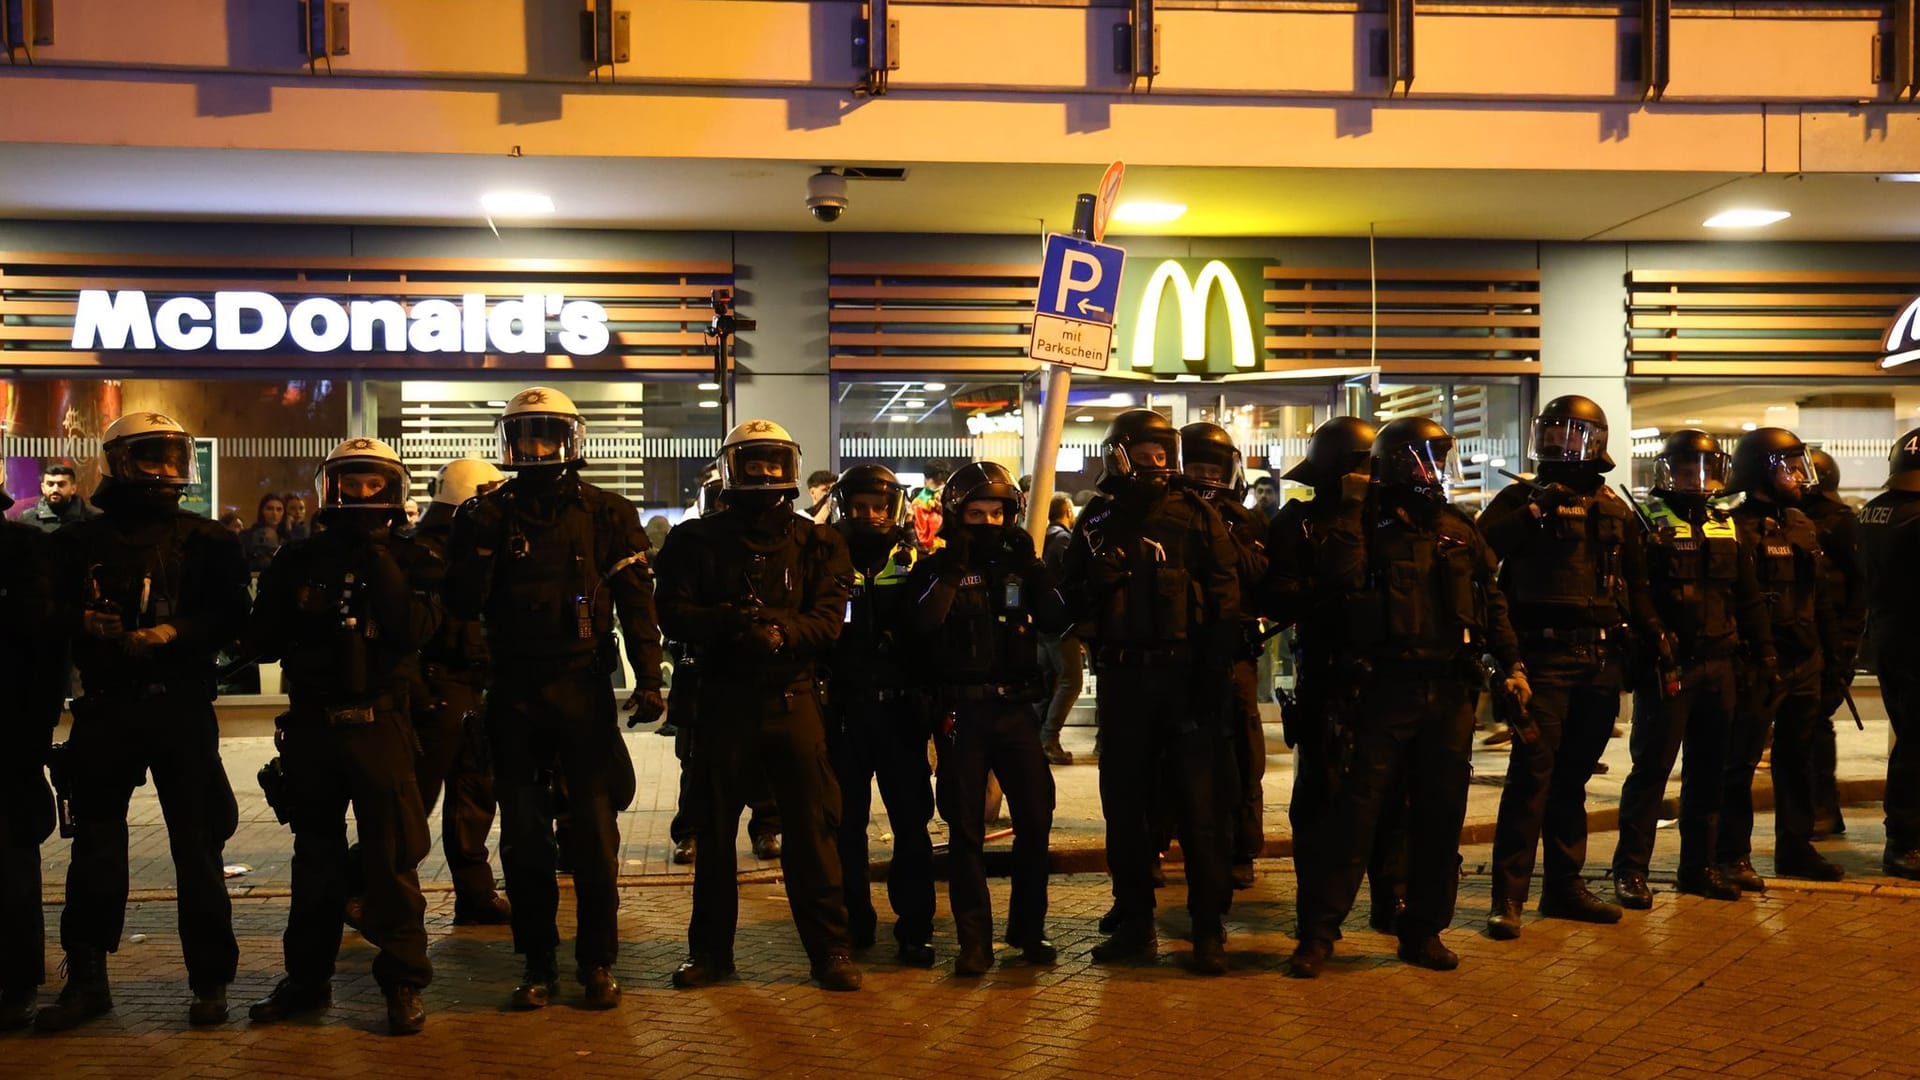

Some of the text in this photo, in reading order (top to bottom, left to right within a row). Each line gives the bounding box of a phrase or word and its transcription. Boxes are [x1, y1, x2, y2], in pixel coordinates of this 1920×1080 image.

[1055, 248, 1103, 313] P
[71, 289, 610, 356] McDonald's
[1062, 330, 1082, 342] mit
[1037, 338, 1103, 361] Parkschein
[1903, 435, 1920, 455] 4
[1857, 506, 1893, 525] OLIZEI
